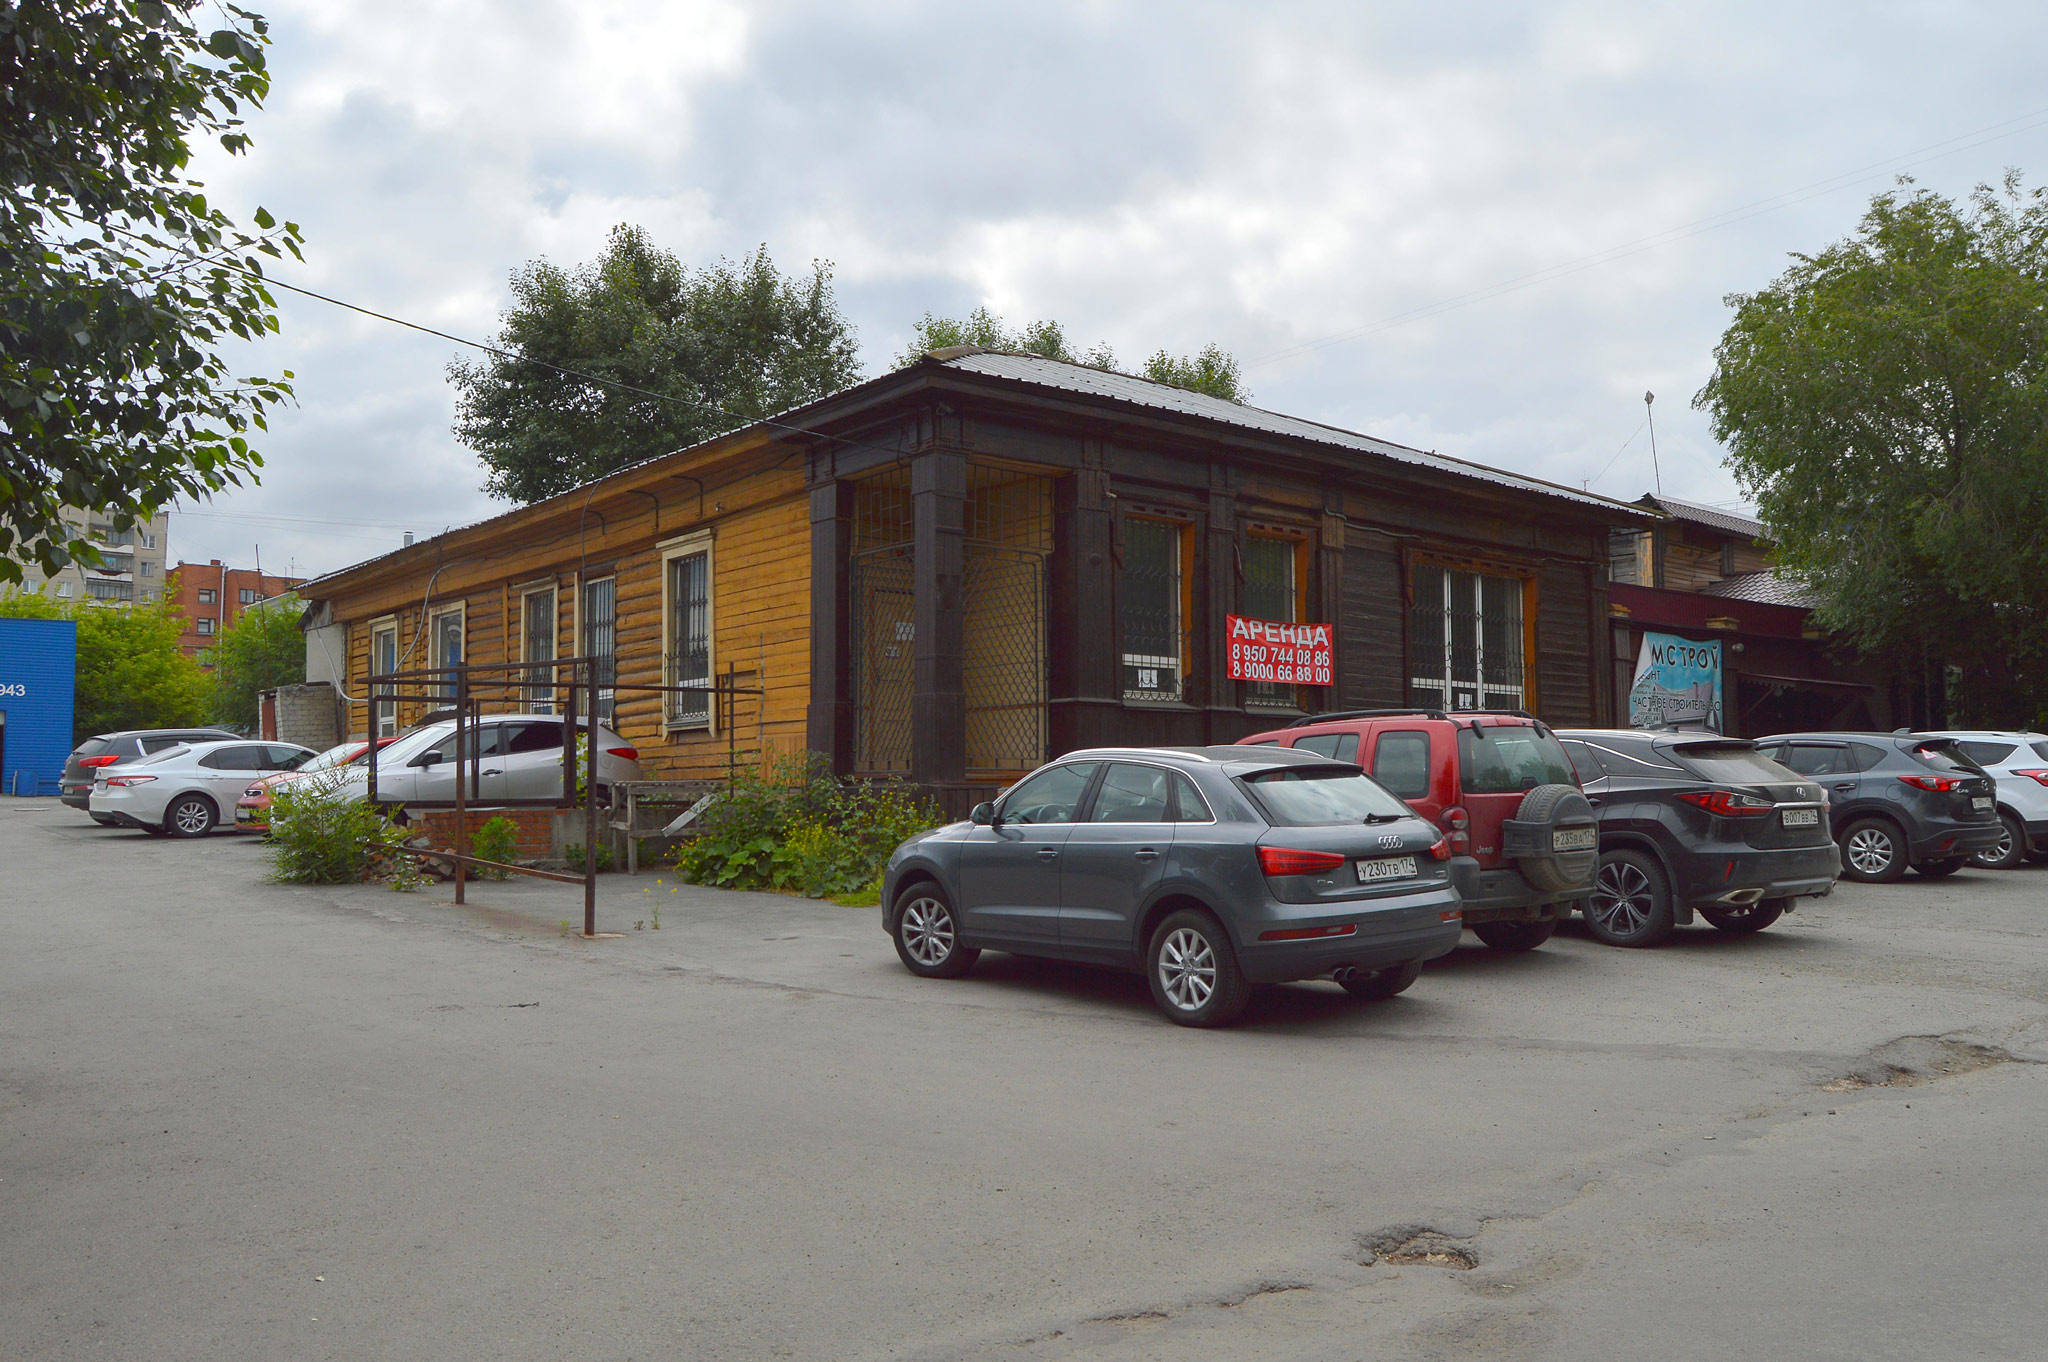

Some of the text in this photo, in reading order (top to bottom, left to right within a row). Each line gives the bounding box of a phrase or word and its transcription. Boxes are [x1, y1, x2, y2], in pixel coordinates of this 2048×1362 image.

[1232, 618, 1329, 649] АРЕНДА
[1232, 643, 1330, 667] 8 950 744 08 86
[1233, 660, 1330, 683] 8 9000 66 88 00
[0, 684, 25, 697] 943
[1360, 858, 1416, 878] У230ТВ 174
